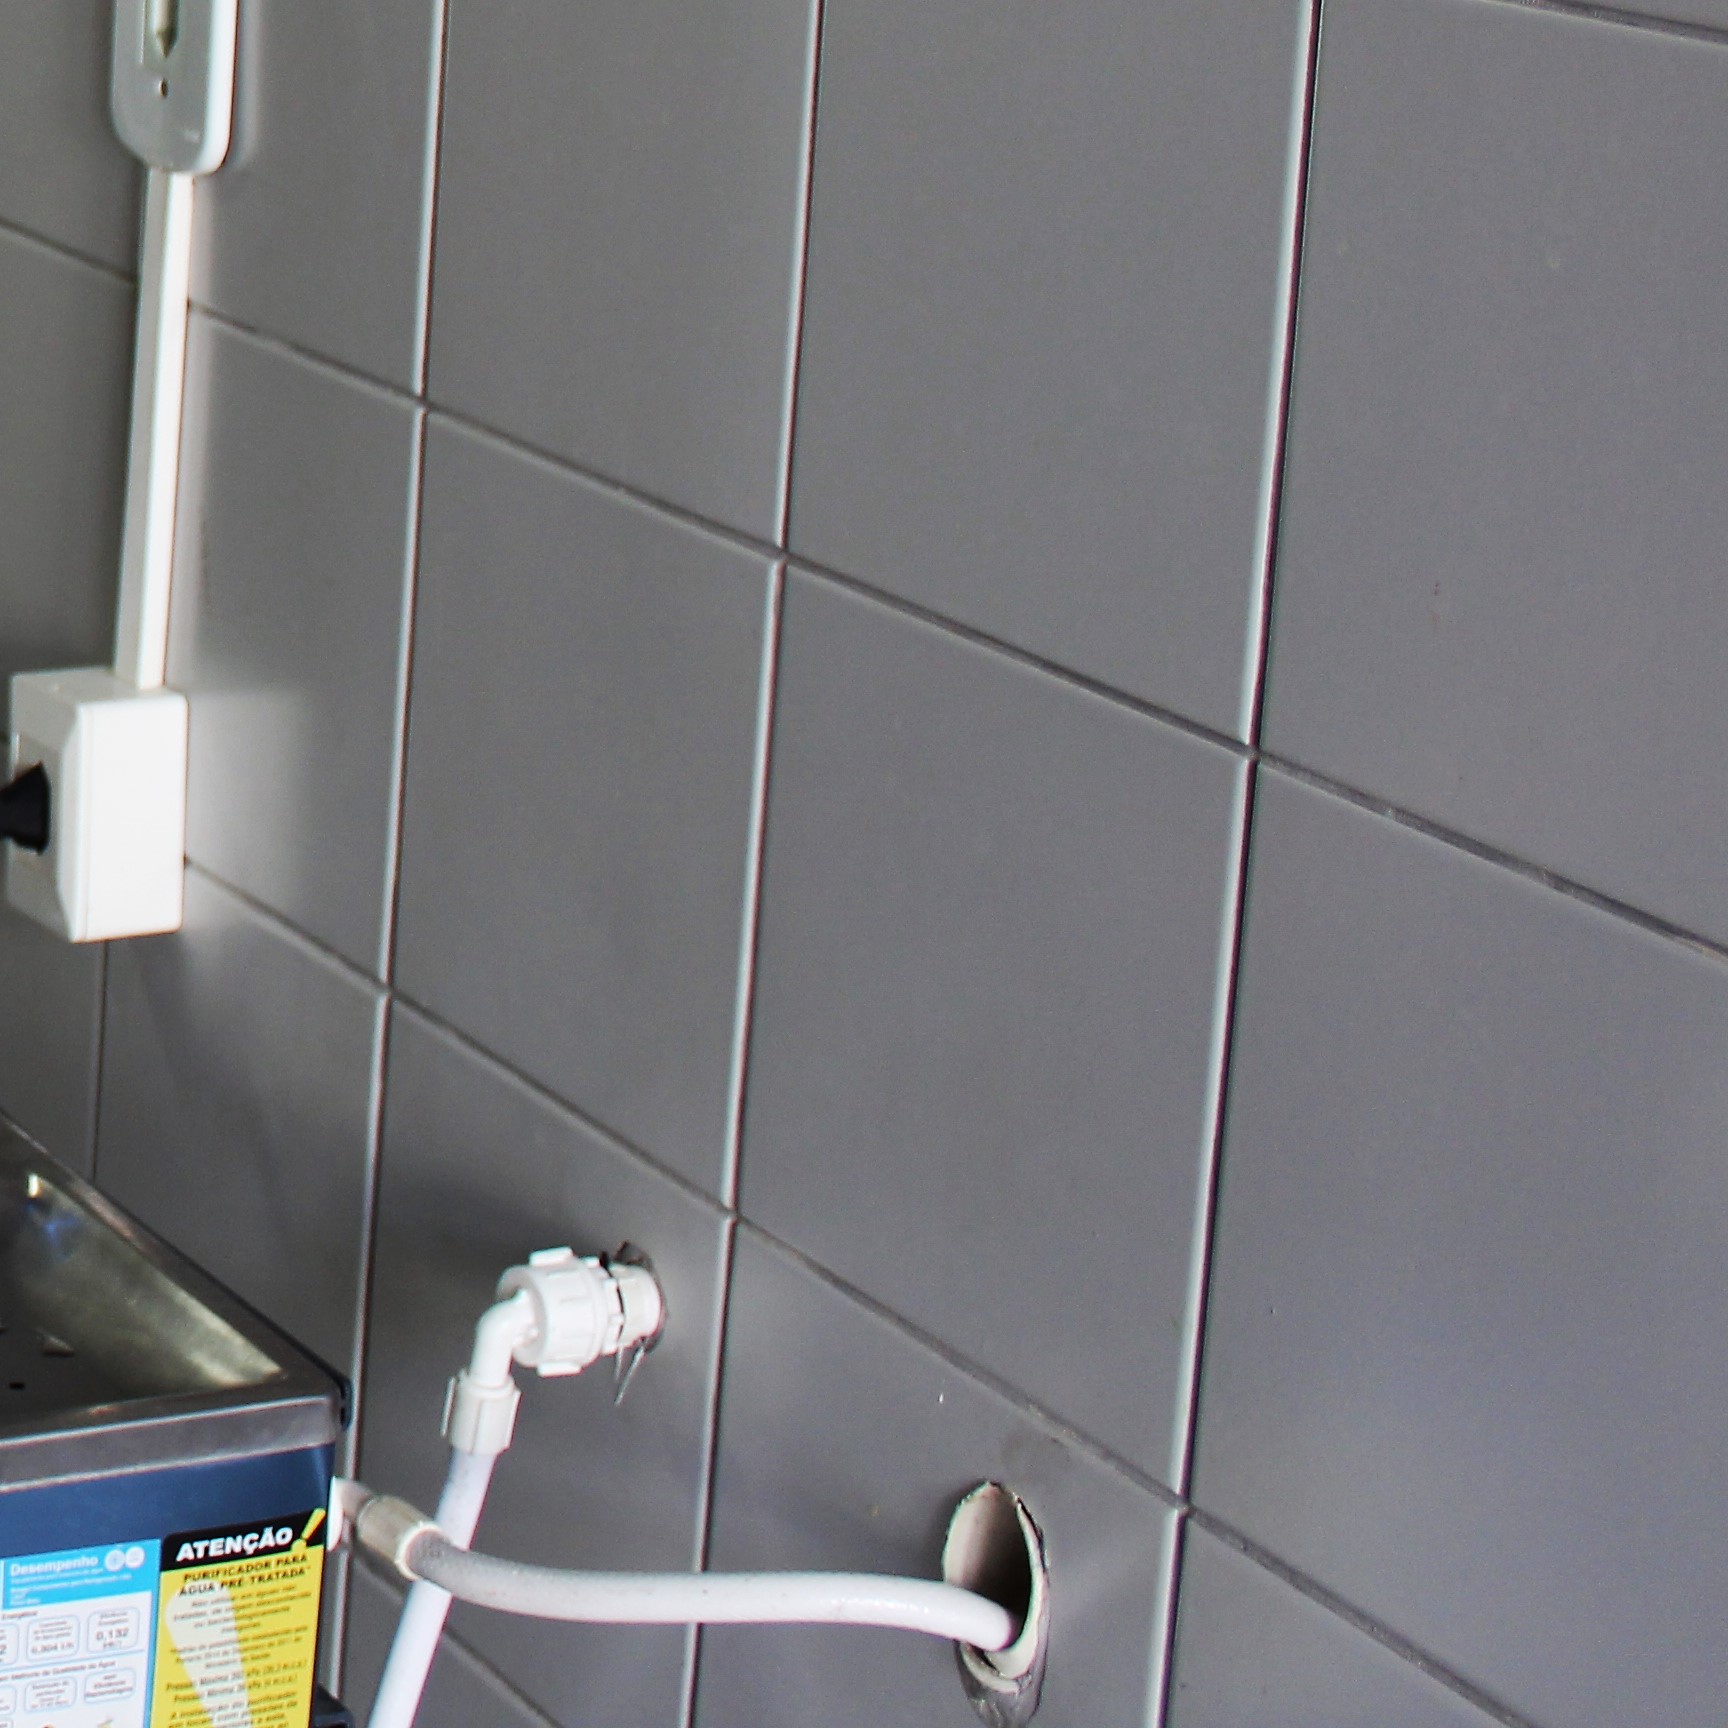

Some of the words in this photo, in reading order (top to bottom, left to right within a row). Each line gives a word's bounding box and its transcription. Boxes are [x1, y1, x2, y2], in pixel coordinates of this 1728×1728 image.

[176, 1526, 294, 1563] ATENÇÃO
[10, 1556, 99, 1576] Desempenho
[184, 1560, 272, 1582] PURIFICADOR
[277, 1554, 308, 1568] PARA
